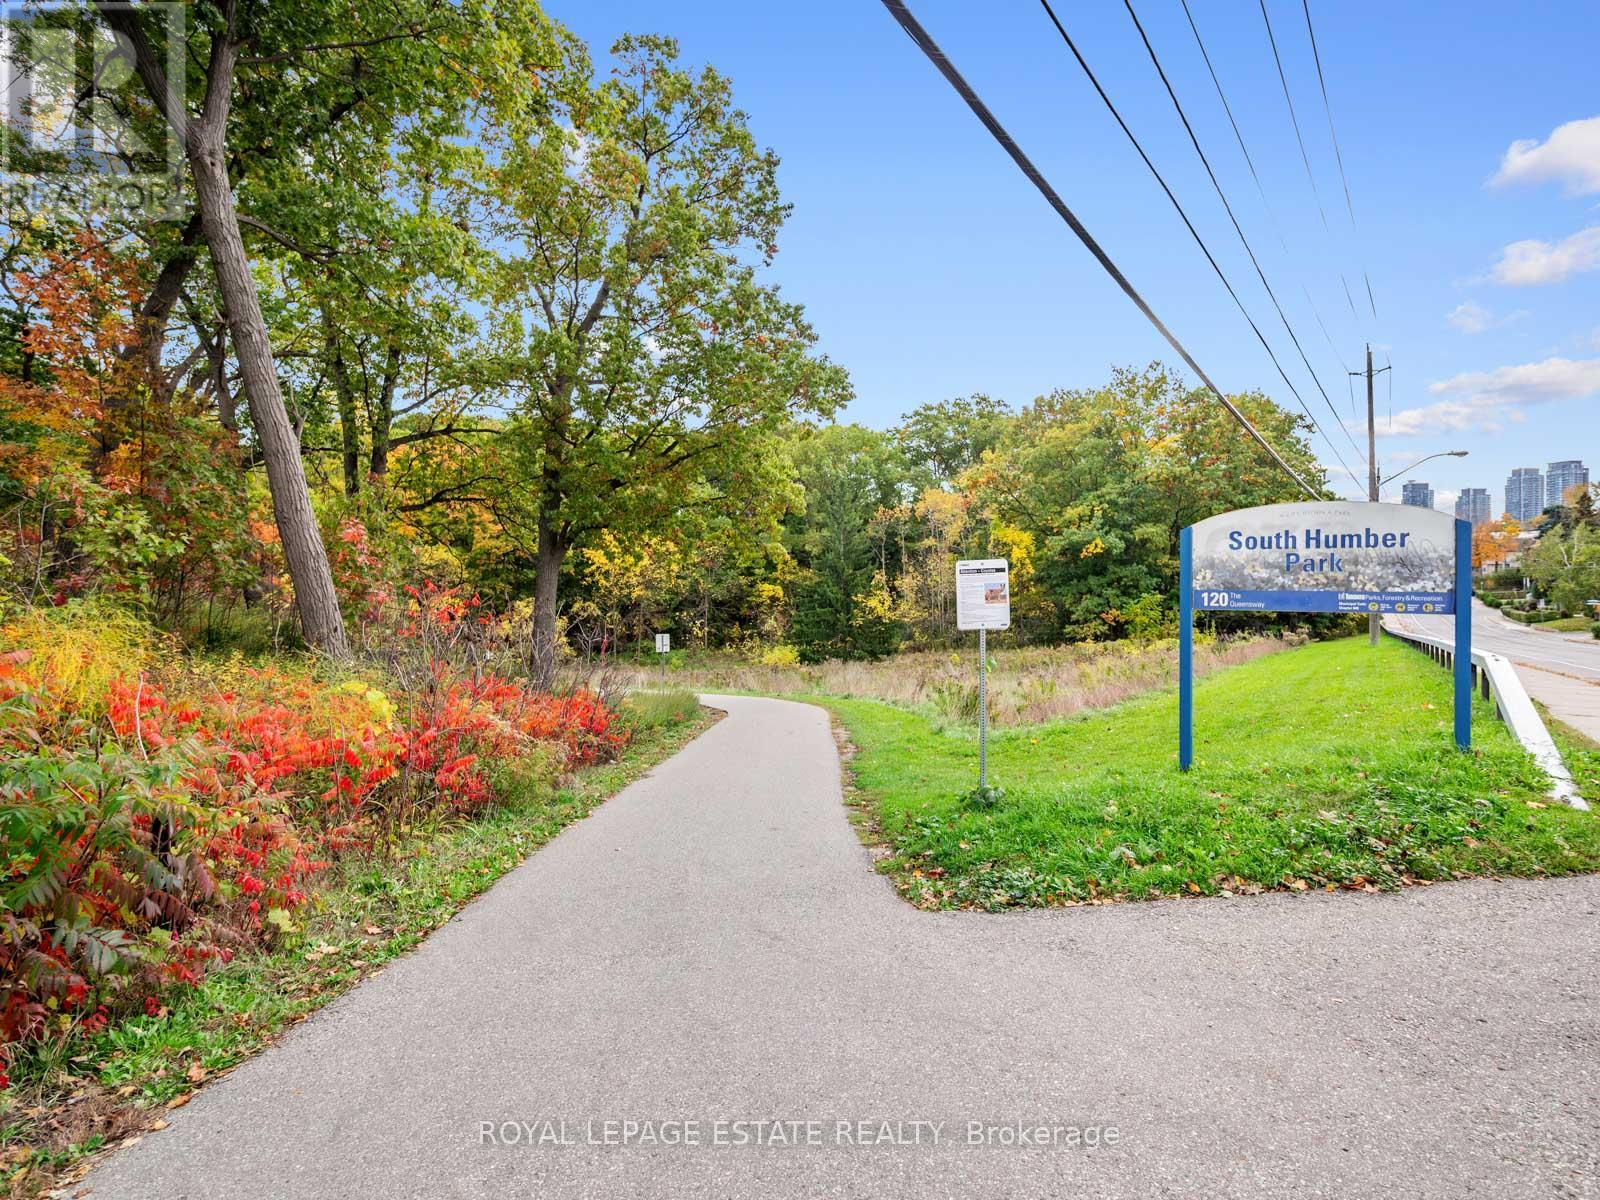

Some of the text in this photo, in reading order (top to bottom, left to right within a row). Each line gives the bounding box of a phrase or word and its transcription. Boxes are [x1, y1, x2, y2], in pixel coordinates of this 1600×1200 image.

[1229, 528, 1410, 551] South Humber
[1285, 552, 1343, 573] Park
[1201, 592, 1229, 607] 120
[1230, 600, 1265, 609] Queensway
[1382, 595, 1405, 603] Forestry
